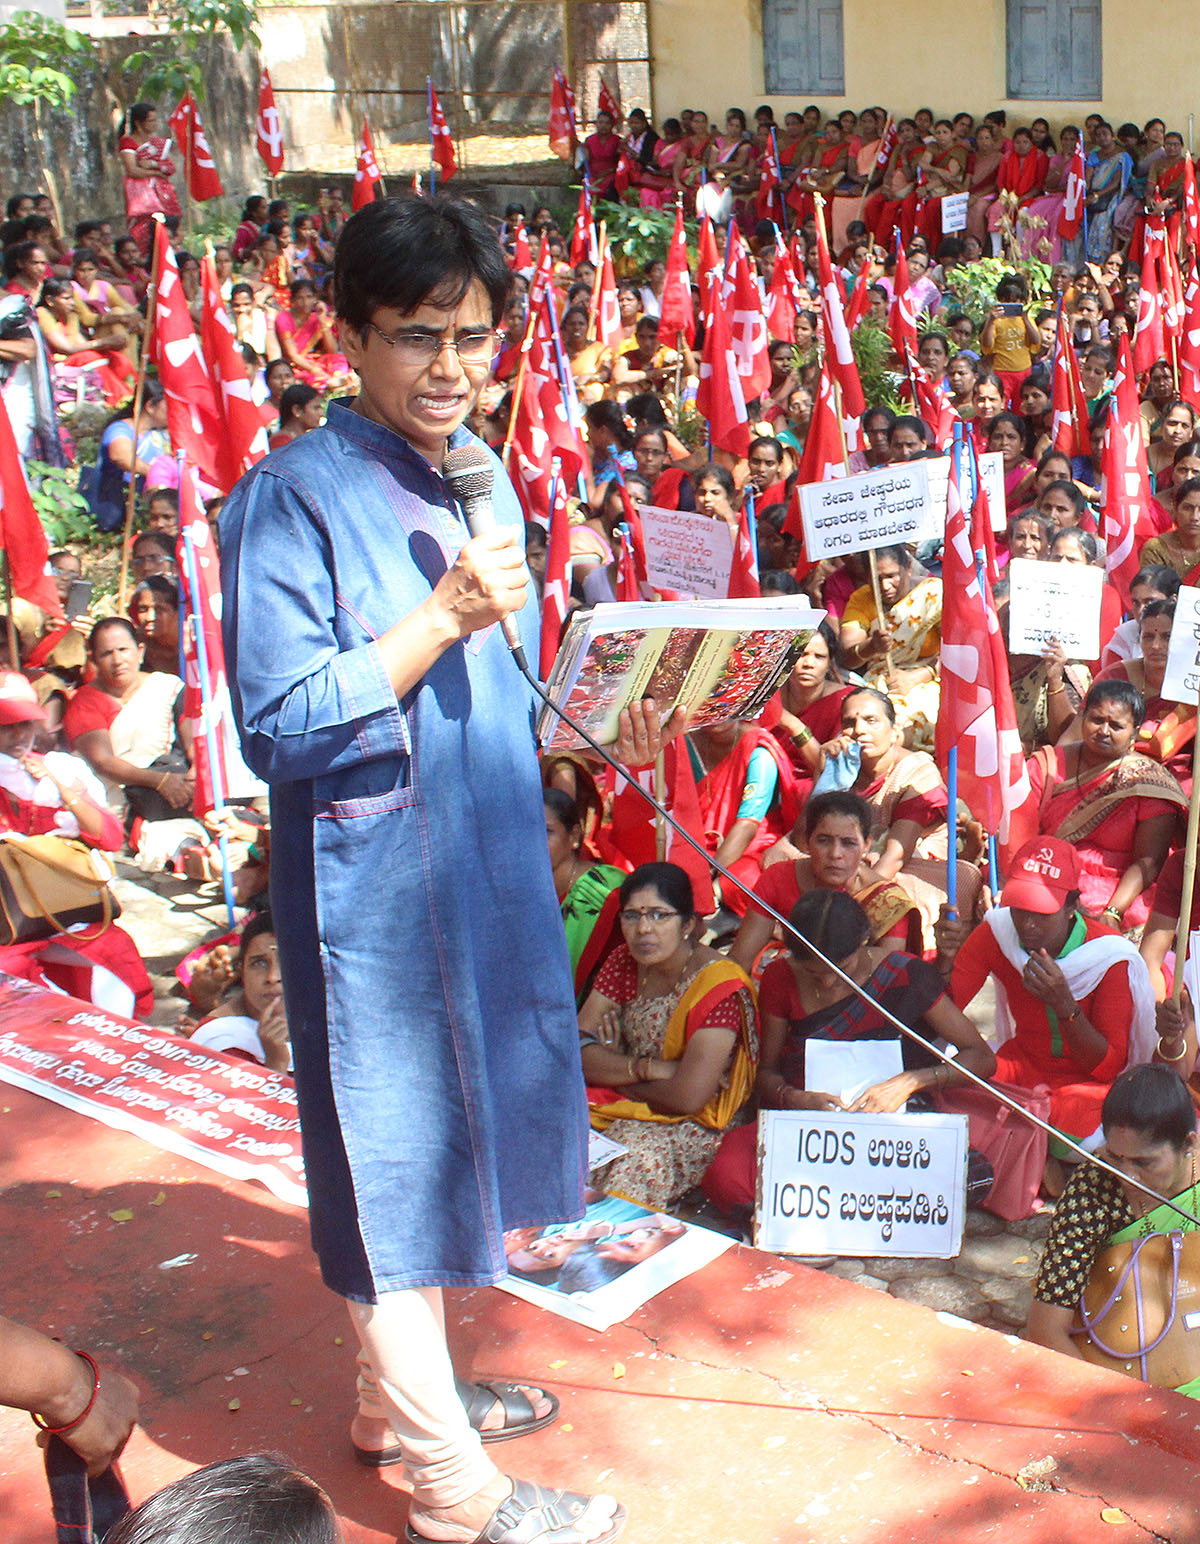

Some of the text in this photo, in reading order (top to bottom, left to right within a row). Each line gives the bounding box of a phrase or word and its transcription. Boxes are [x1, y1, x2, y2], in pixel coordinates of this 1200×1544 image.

[1023, 859, 1061, 879] CITU
[143, 1036, 230, 1080] LKG-UKG
[797, 1128, 931, 1169] ICDS ಉಳಿಸಿ
[773, 1182, 949, 1242] ICDS ಬಲಿಷ್ಠಪಡಿಸಿ
